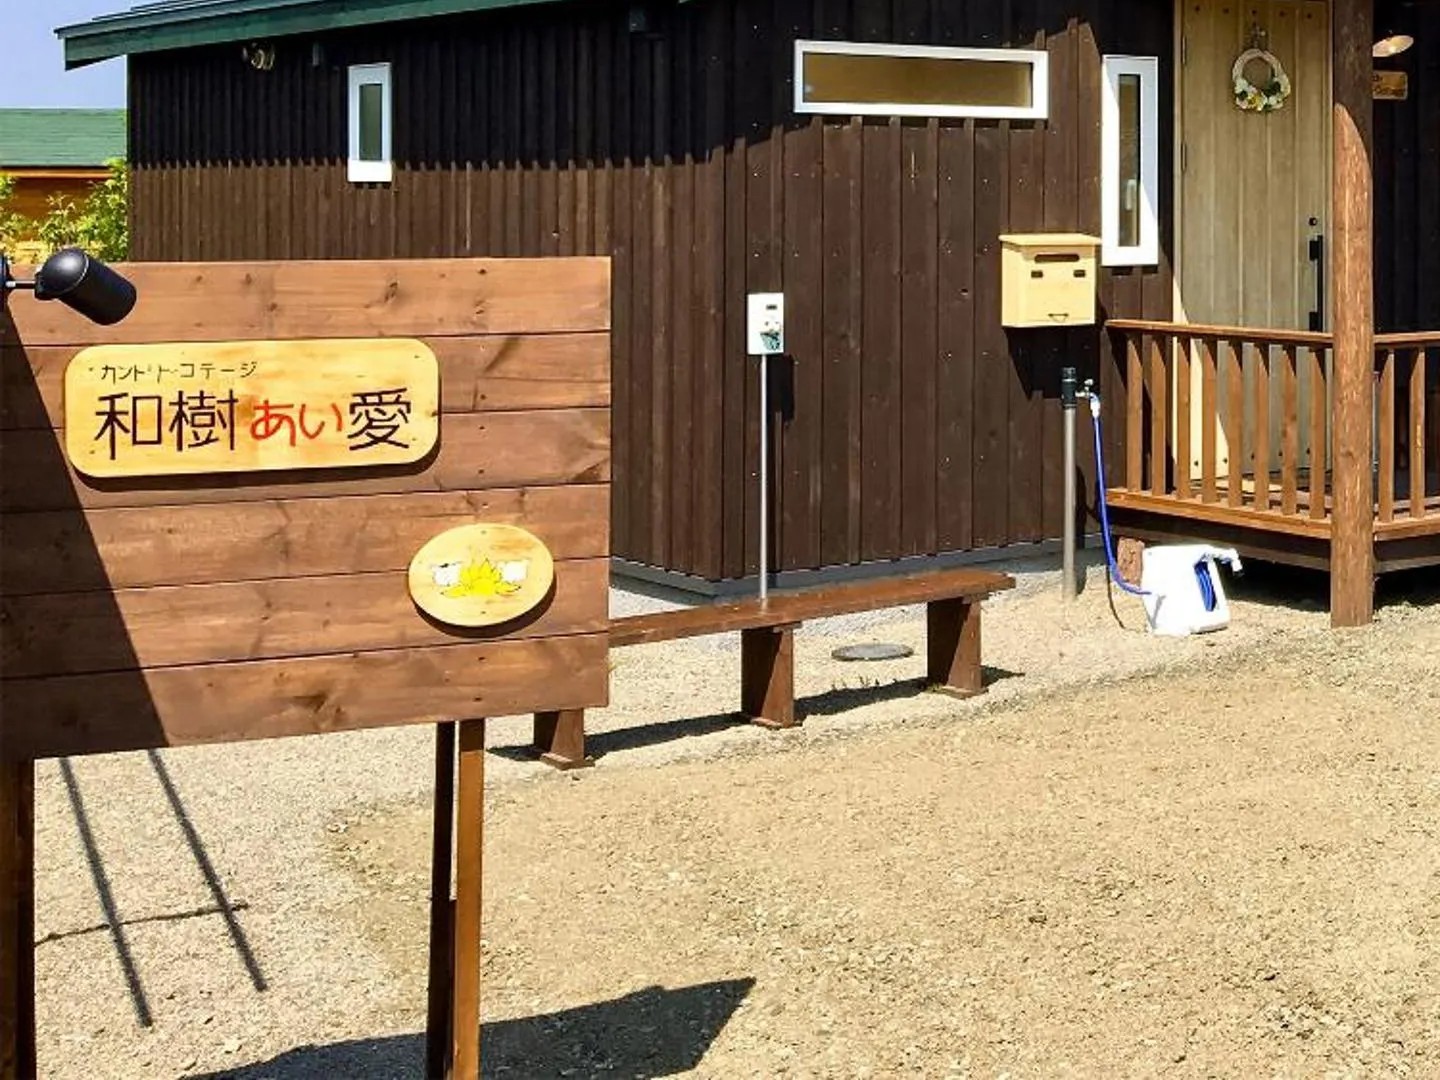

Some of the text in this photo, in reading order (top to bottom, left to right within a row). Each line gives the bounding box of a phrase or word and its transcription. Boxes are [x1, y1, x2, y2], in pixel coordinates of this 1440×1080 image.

[94, 388, 411, 460] 和樹あい愛
